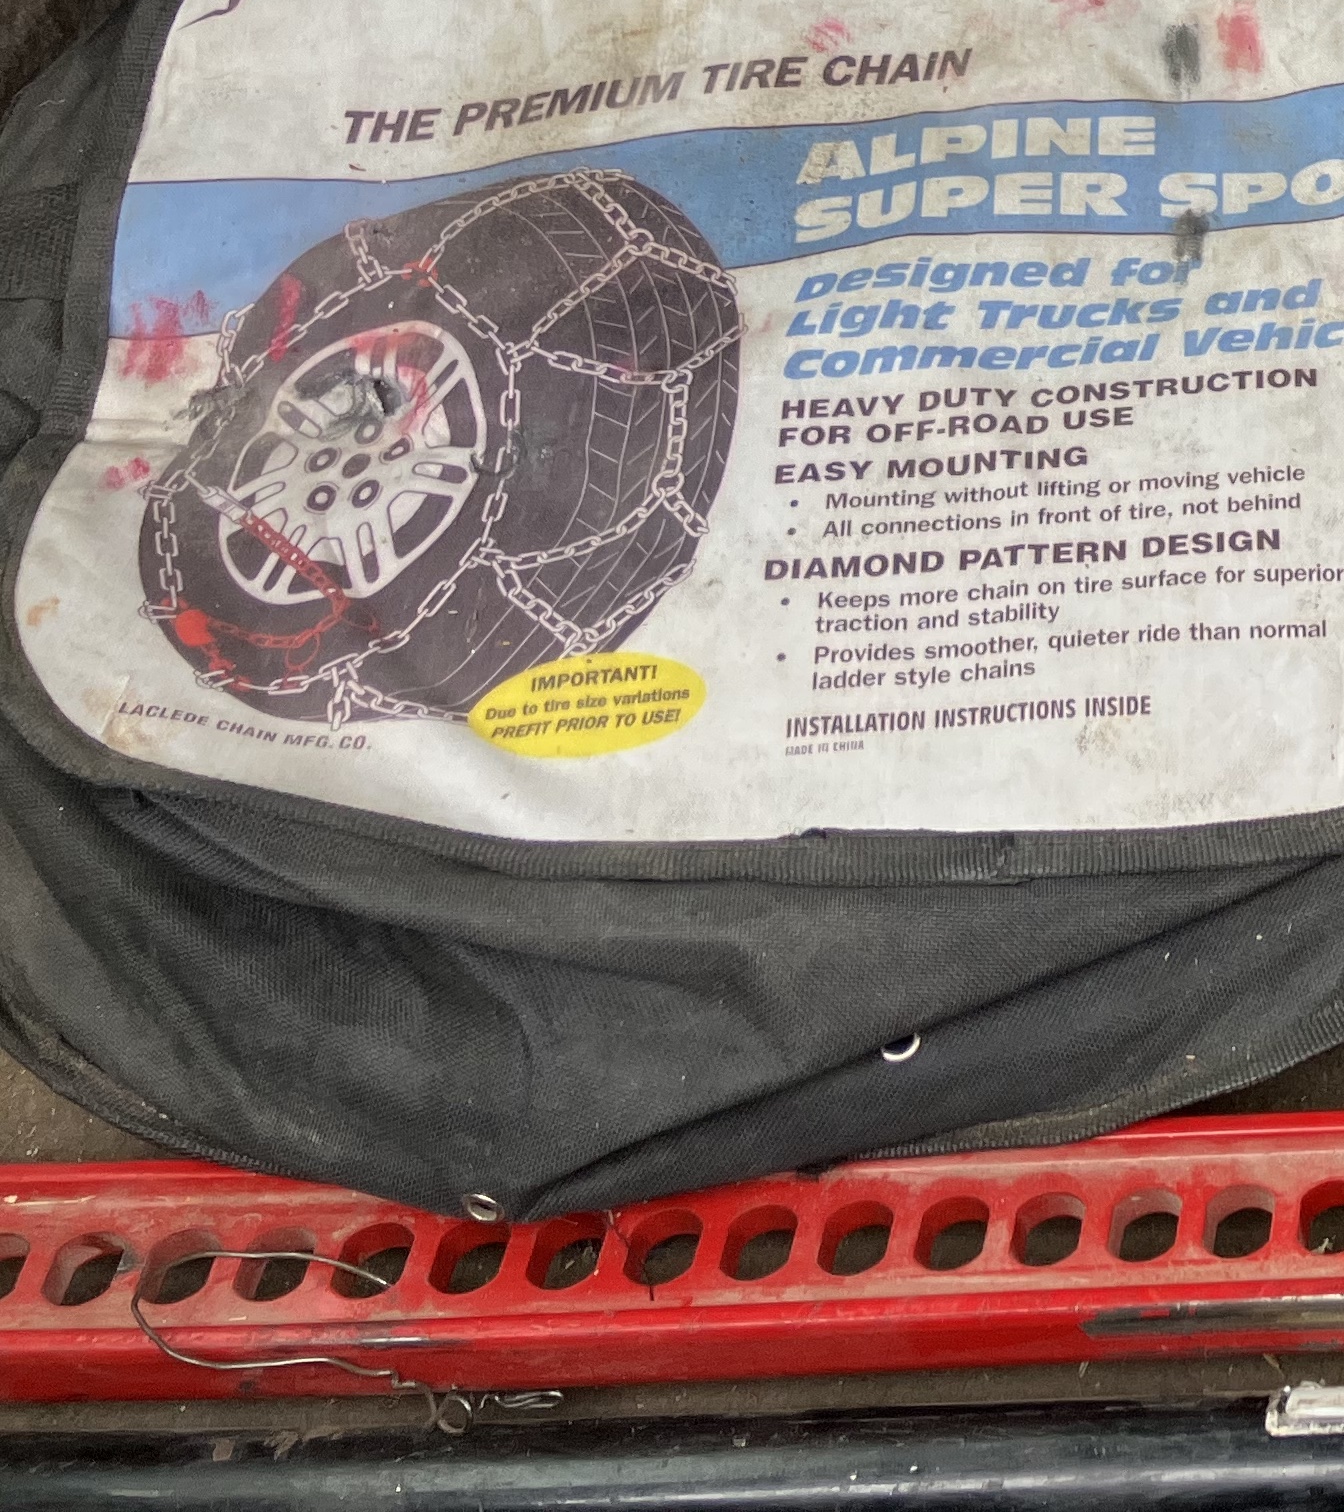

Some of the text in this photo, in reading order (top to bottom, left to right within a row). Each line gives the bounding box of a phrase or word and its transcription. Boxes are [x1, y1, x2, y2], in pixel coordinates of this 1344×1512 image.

[344, 48, 973, 144] THE PREMIUM TIRE CHAIN
[795, 116, 1156, 185] ALPINE
[794, 172, 1129, 243] SUPER
[794, 256, 1200, 304] Designed for
[786, 279, 1322, 338] Light Trucks and
[783, 335, 1158, 381] Commercial
[781, 368, 1319, 420] HEAVY DUTY CONSTRUCTION
[778, 406, 1134, 447] FOR OFF-ROAD USE
[774, 446, 1089, 485] EASY MOUNTING
[825, 464, 1306, 511] Mounting without lifting or moving vehicle
[822, 491, 1302, 539] All connections in front of tire, not behind
[764, 528, 1282, 581] DIAMOND PATTERN DESIGN
[817, 564, 1344, 611] Keeps more chain on tire surface for superior
[815, 600, 1060, 634] traction and stability
[814, 619, 1327, 665] Provides smoother, quieter ride than normal
[531, 664, 658, 693] IMPORTANT!
[812, 658, 1036, 691] ladder style chains
[118, 701, 372, 750] LACLEDE CHAIN MFG. CO.
[485, 688, 690, 721] Due to tire size variations
[491, 708, 681, 738] PREFIT PRIOR TO USE!
[786, 694, 1151, 738] INSTALLATION INSTRUCTIONS INSIDE
[785, 740, 865, 756] MADE IN CHINA
